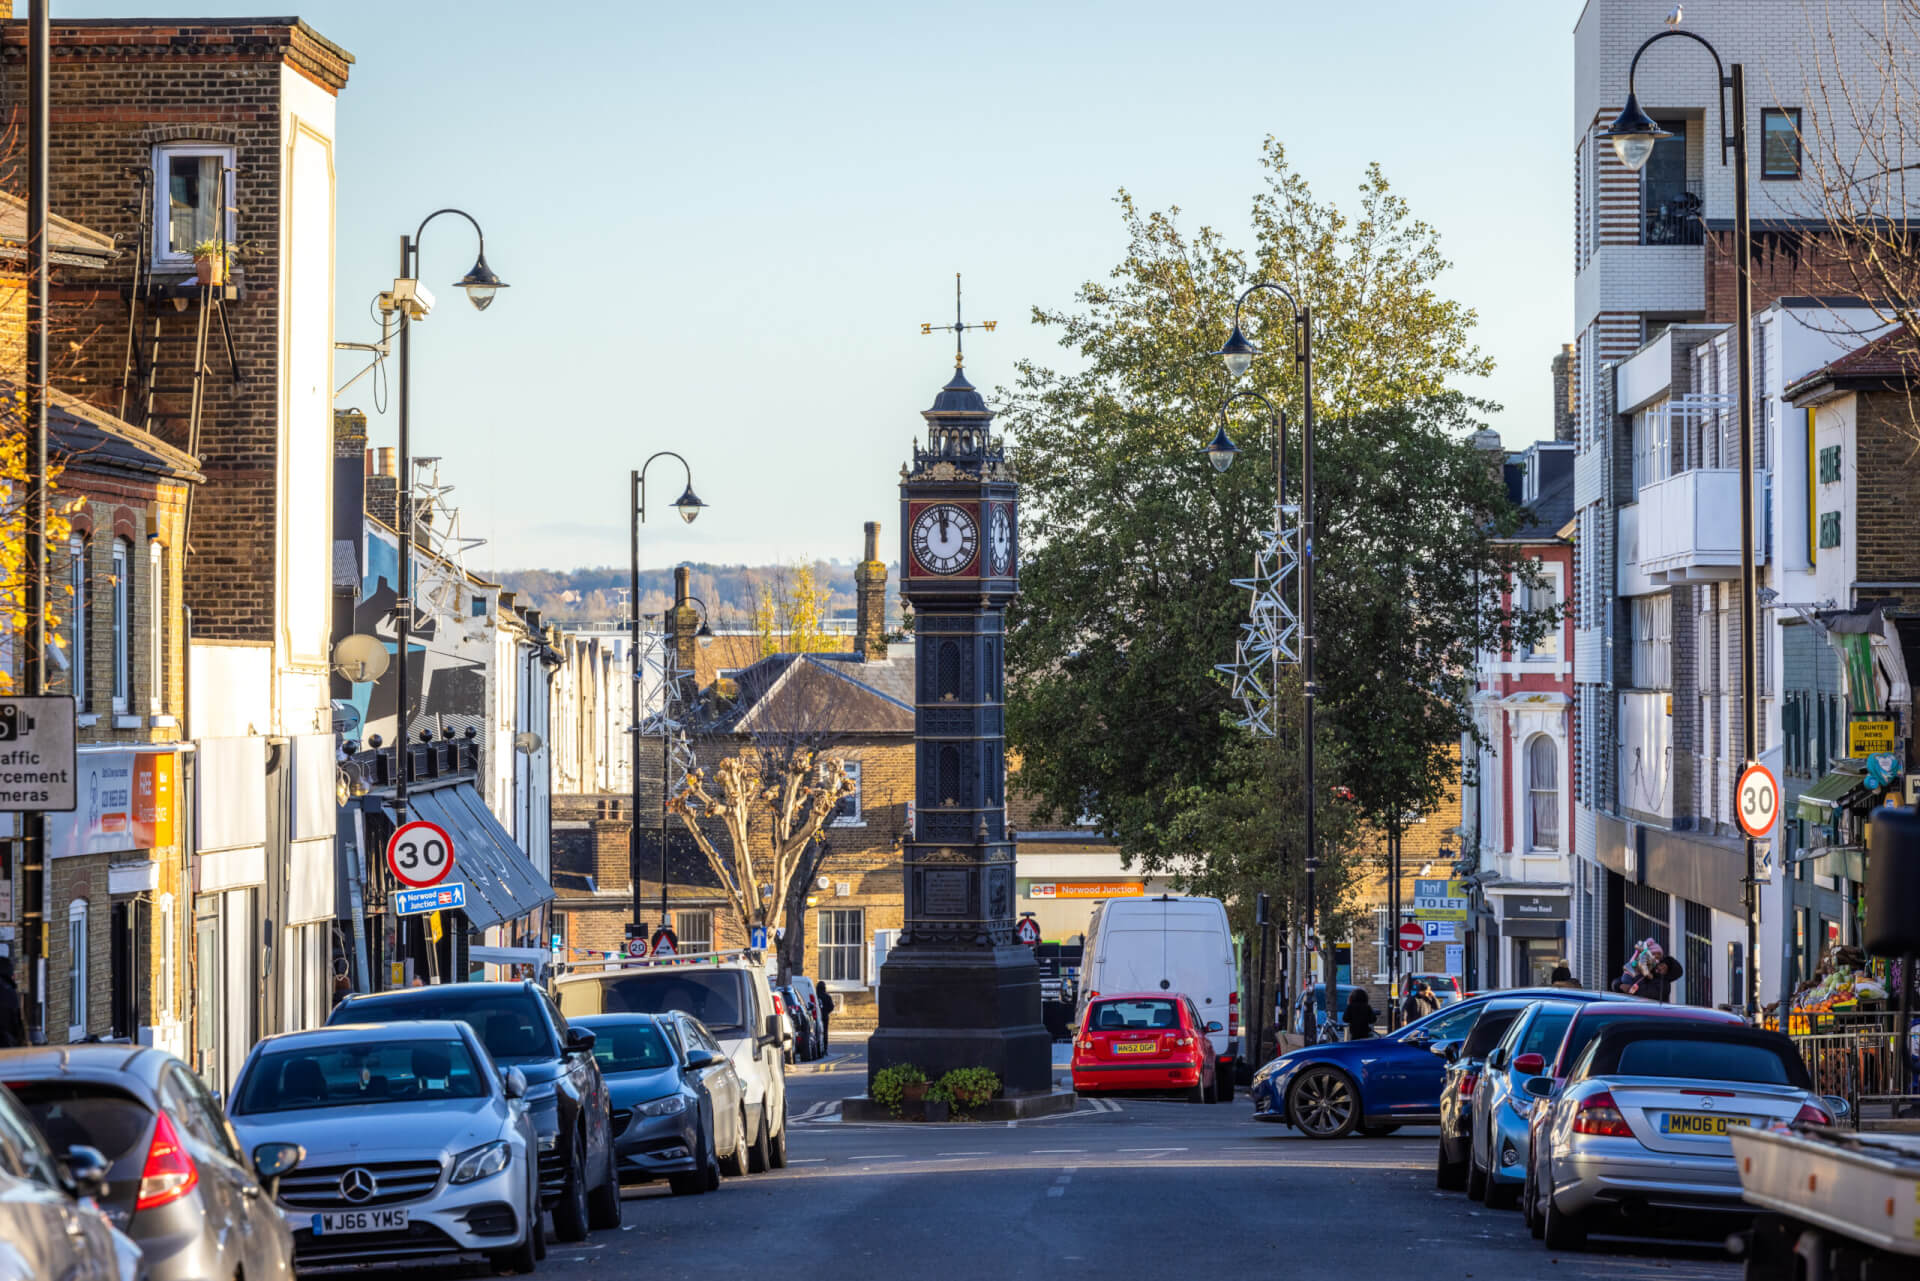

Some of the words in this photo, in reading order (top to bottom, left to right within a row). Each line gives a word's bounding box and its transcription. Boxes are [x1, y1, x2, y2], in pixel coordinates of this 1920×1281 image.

[0, 768, 68, 783] cement
[1743, 786, 1773, 815] 30
[399, 840, 445, 869] 30
[1061, 885, 1100, 894] Norwood
[1102, 885, 1138, 894] Junction
[408, 891, 437, 901] Norwood
[410, 900, 437, 910] Junction
[1420, 899, 1437, 909] TO
[1440, 899, 1464, 909] LET
[1427, 923, 1437, 935] P
[631, 943, 645, 952] 20
[1671, 1114, 1713, 1132] MM06
[323, 1213, 368, 1231] WJ66
[371, 1210, 404, 1228] YMS
